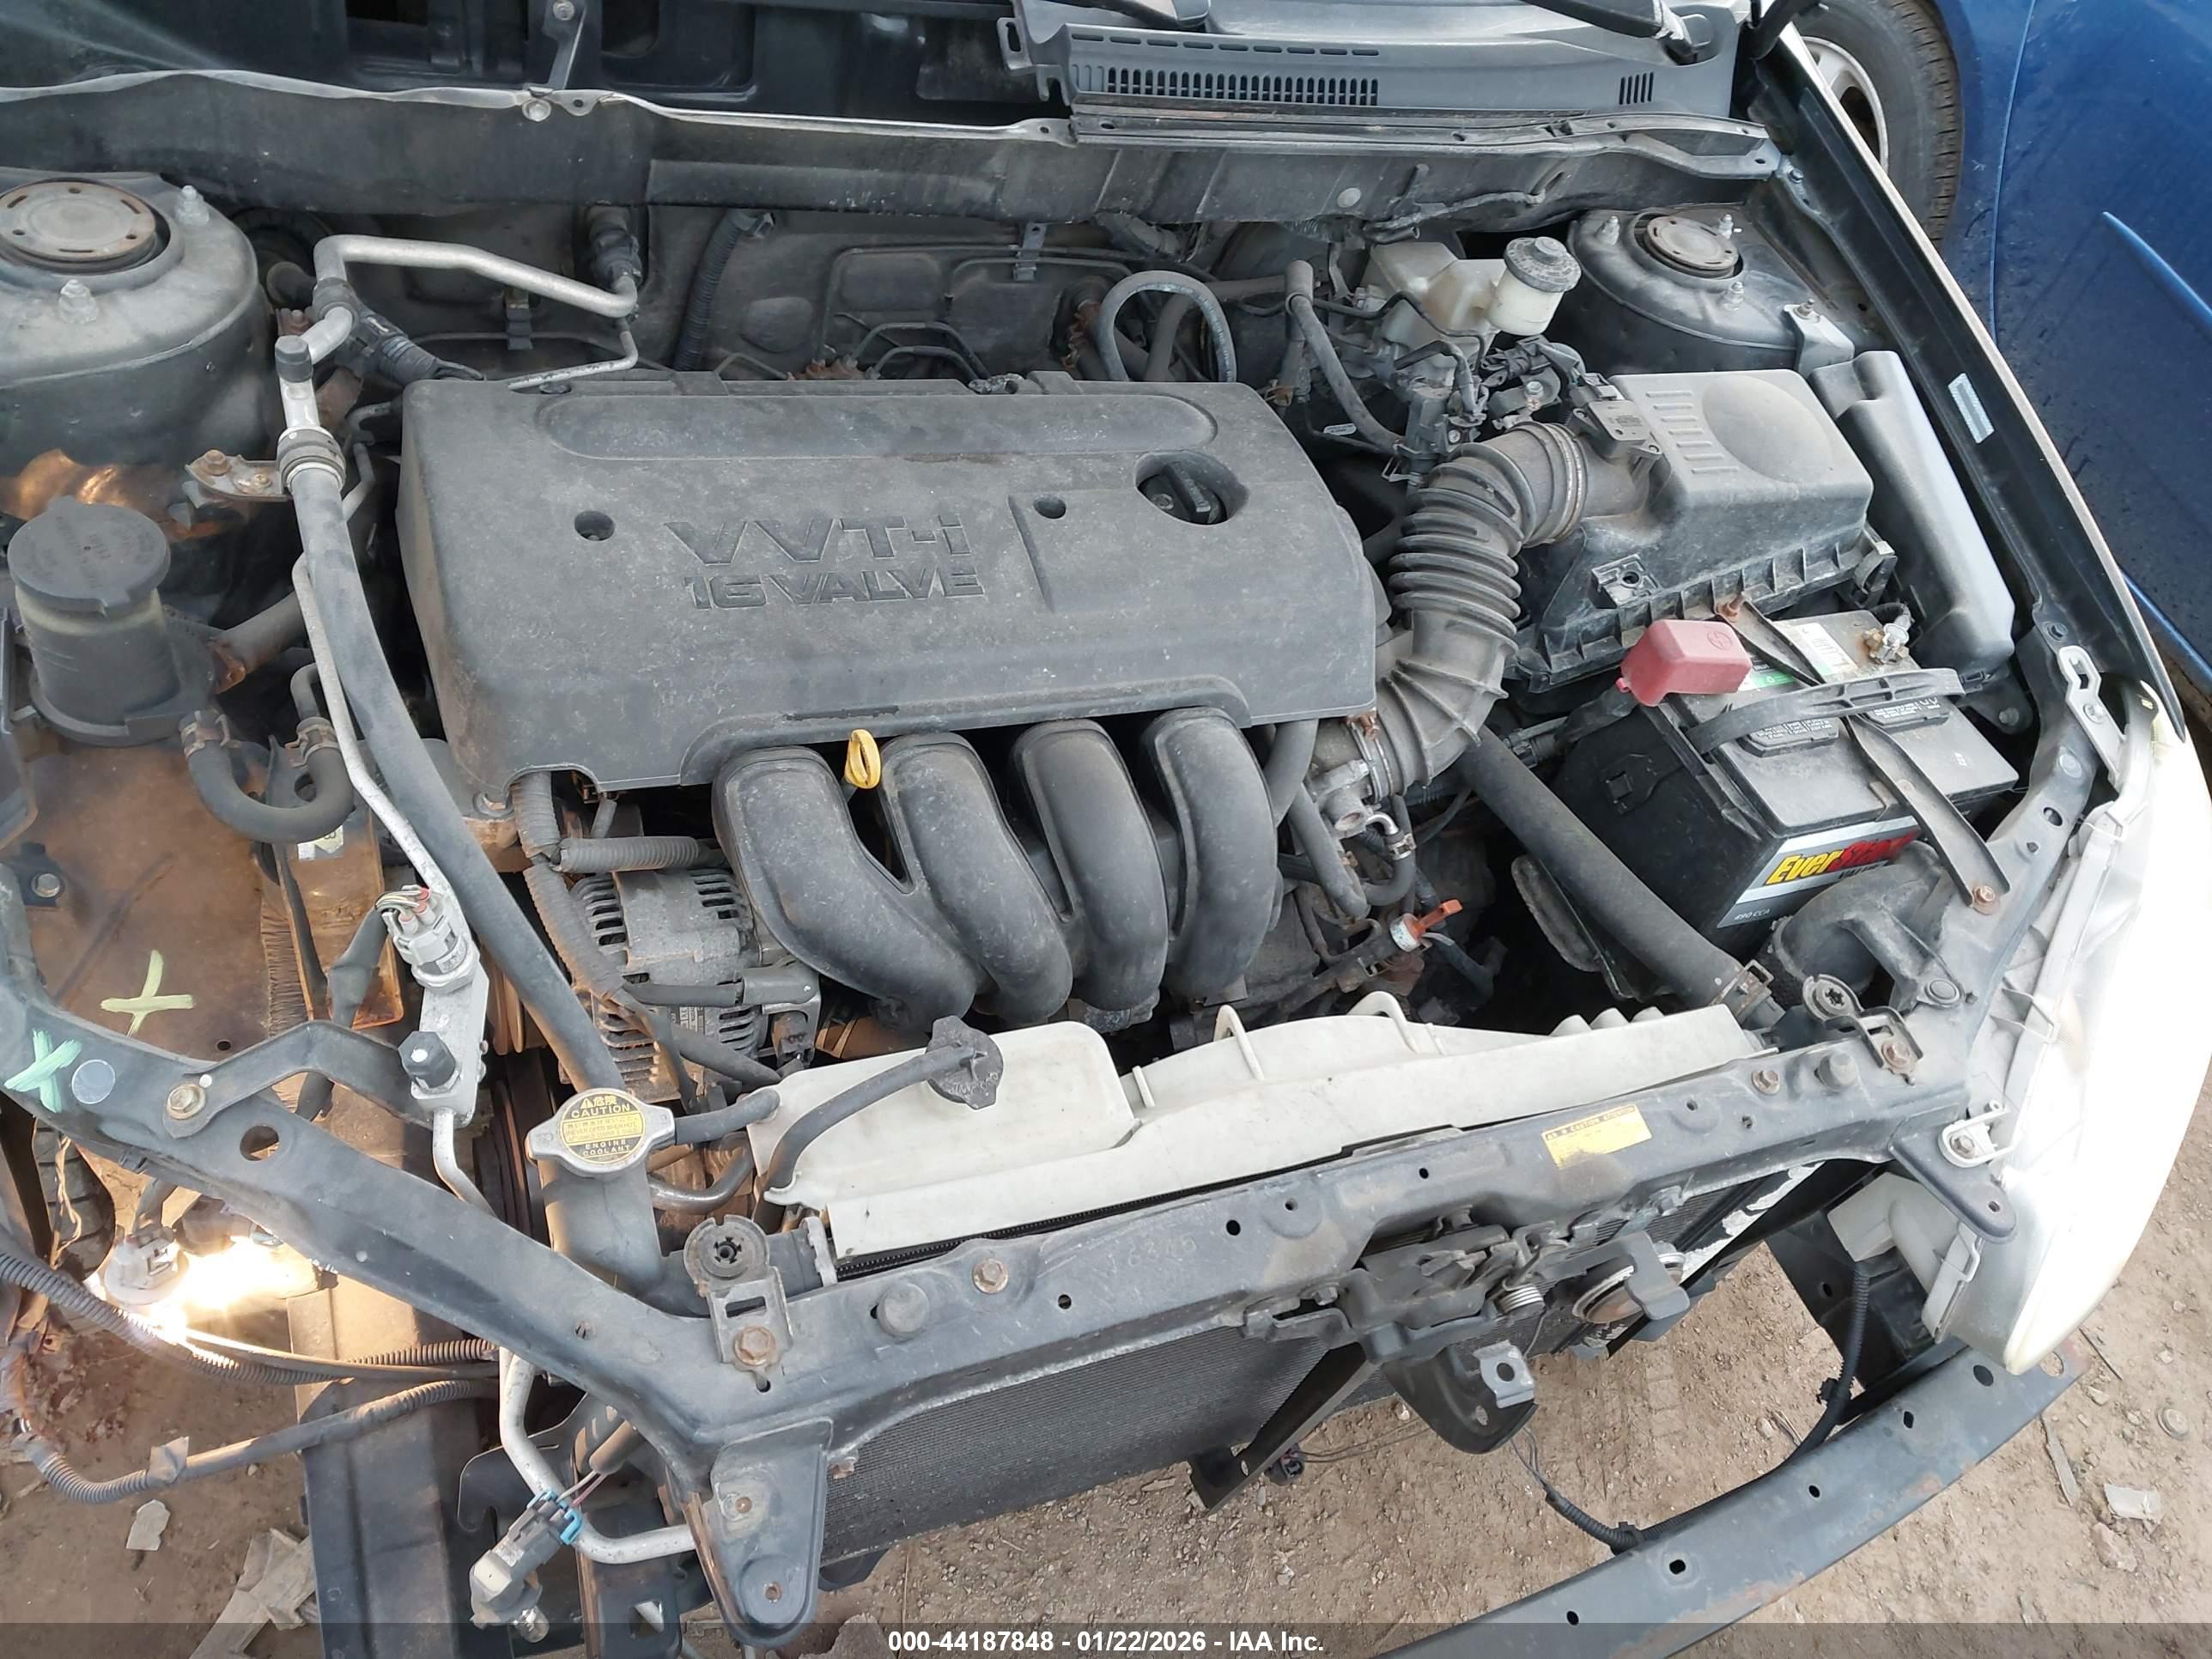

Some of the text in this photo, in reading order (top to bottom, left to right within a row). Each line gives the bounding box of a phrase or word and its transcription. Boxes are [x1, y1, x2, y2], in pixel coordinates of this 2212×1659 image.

[571, 1103, 631, 1118] CAUTION
[585, 1139, 626, 1150] ENGINE
[582, 1145, 631, 1157] COOLANT
